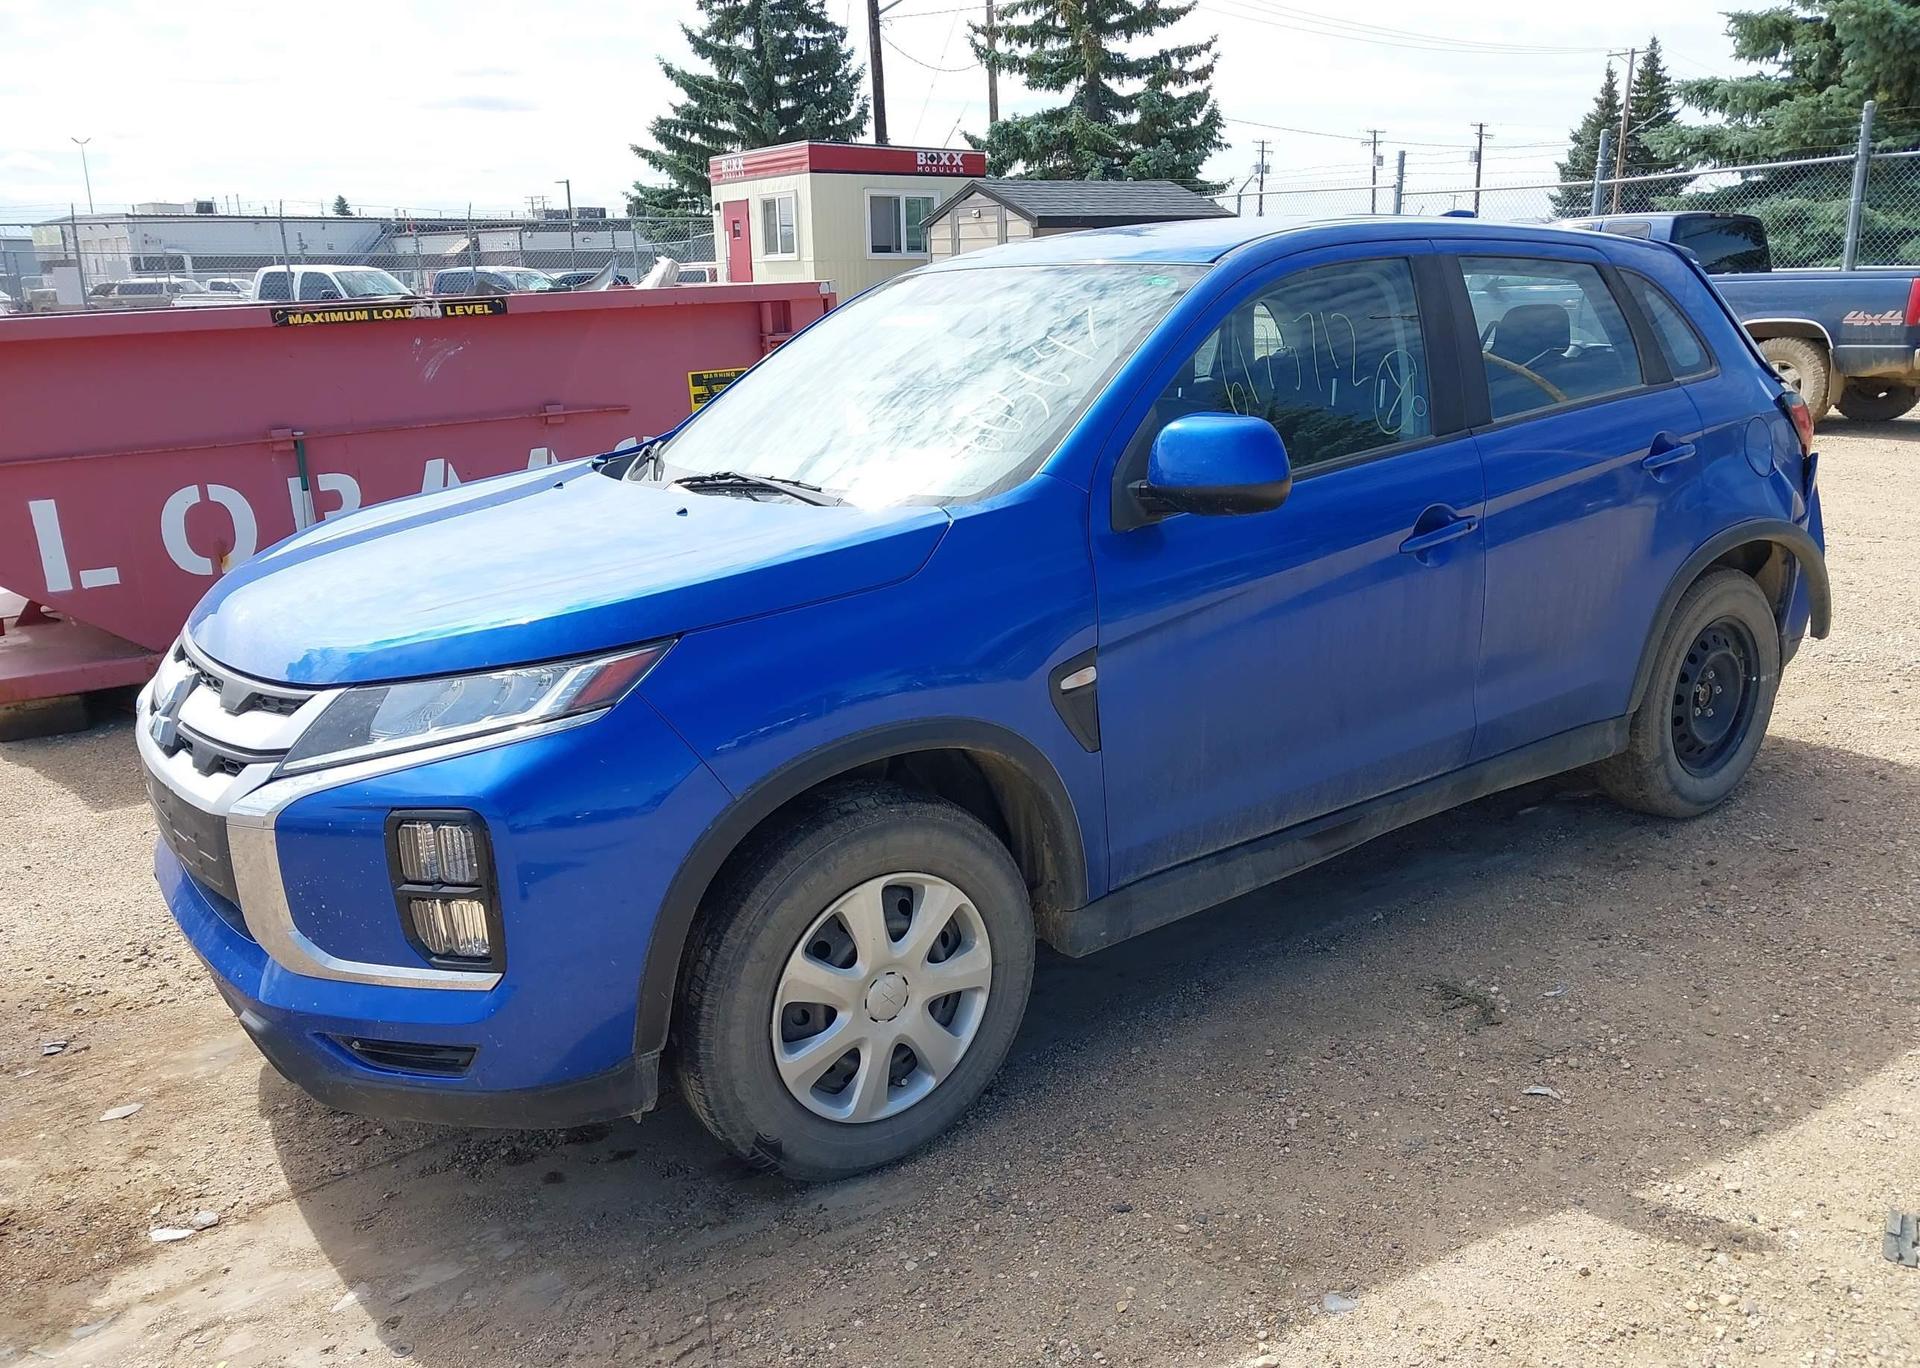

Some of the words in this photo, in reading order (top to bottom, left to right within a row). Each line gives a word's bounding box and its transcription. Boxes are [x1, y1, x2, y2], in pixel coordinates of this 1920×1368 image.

[916, 152, 964, 166] BOXX
[288, 310, 368, 324] MAXIMUM
[446, 304, 493, 316] LEVEL
[1842, 310, 1904, 326] 4x4
[702, 371, 736, 380] WARNING
